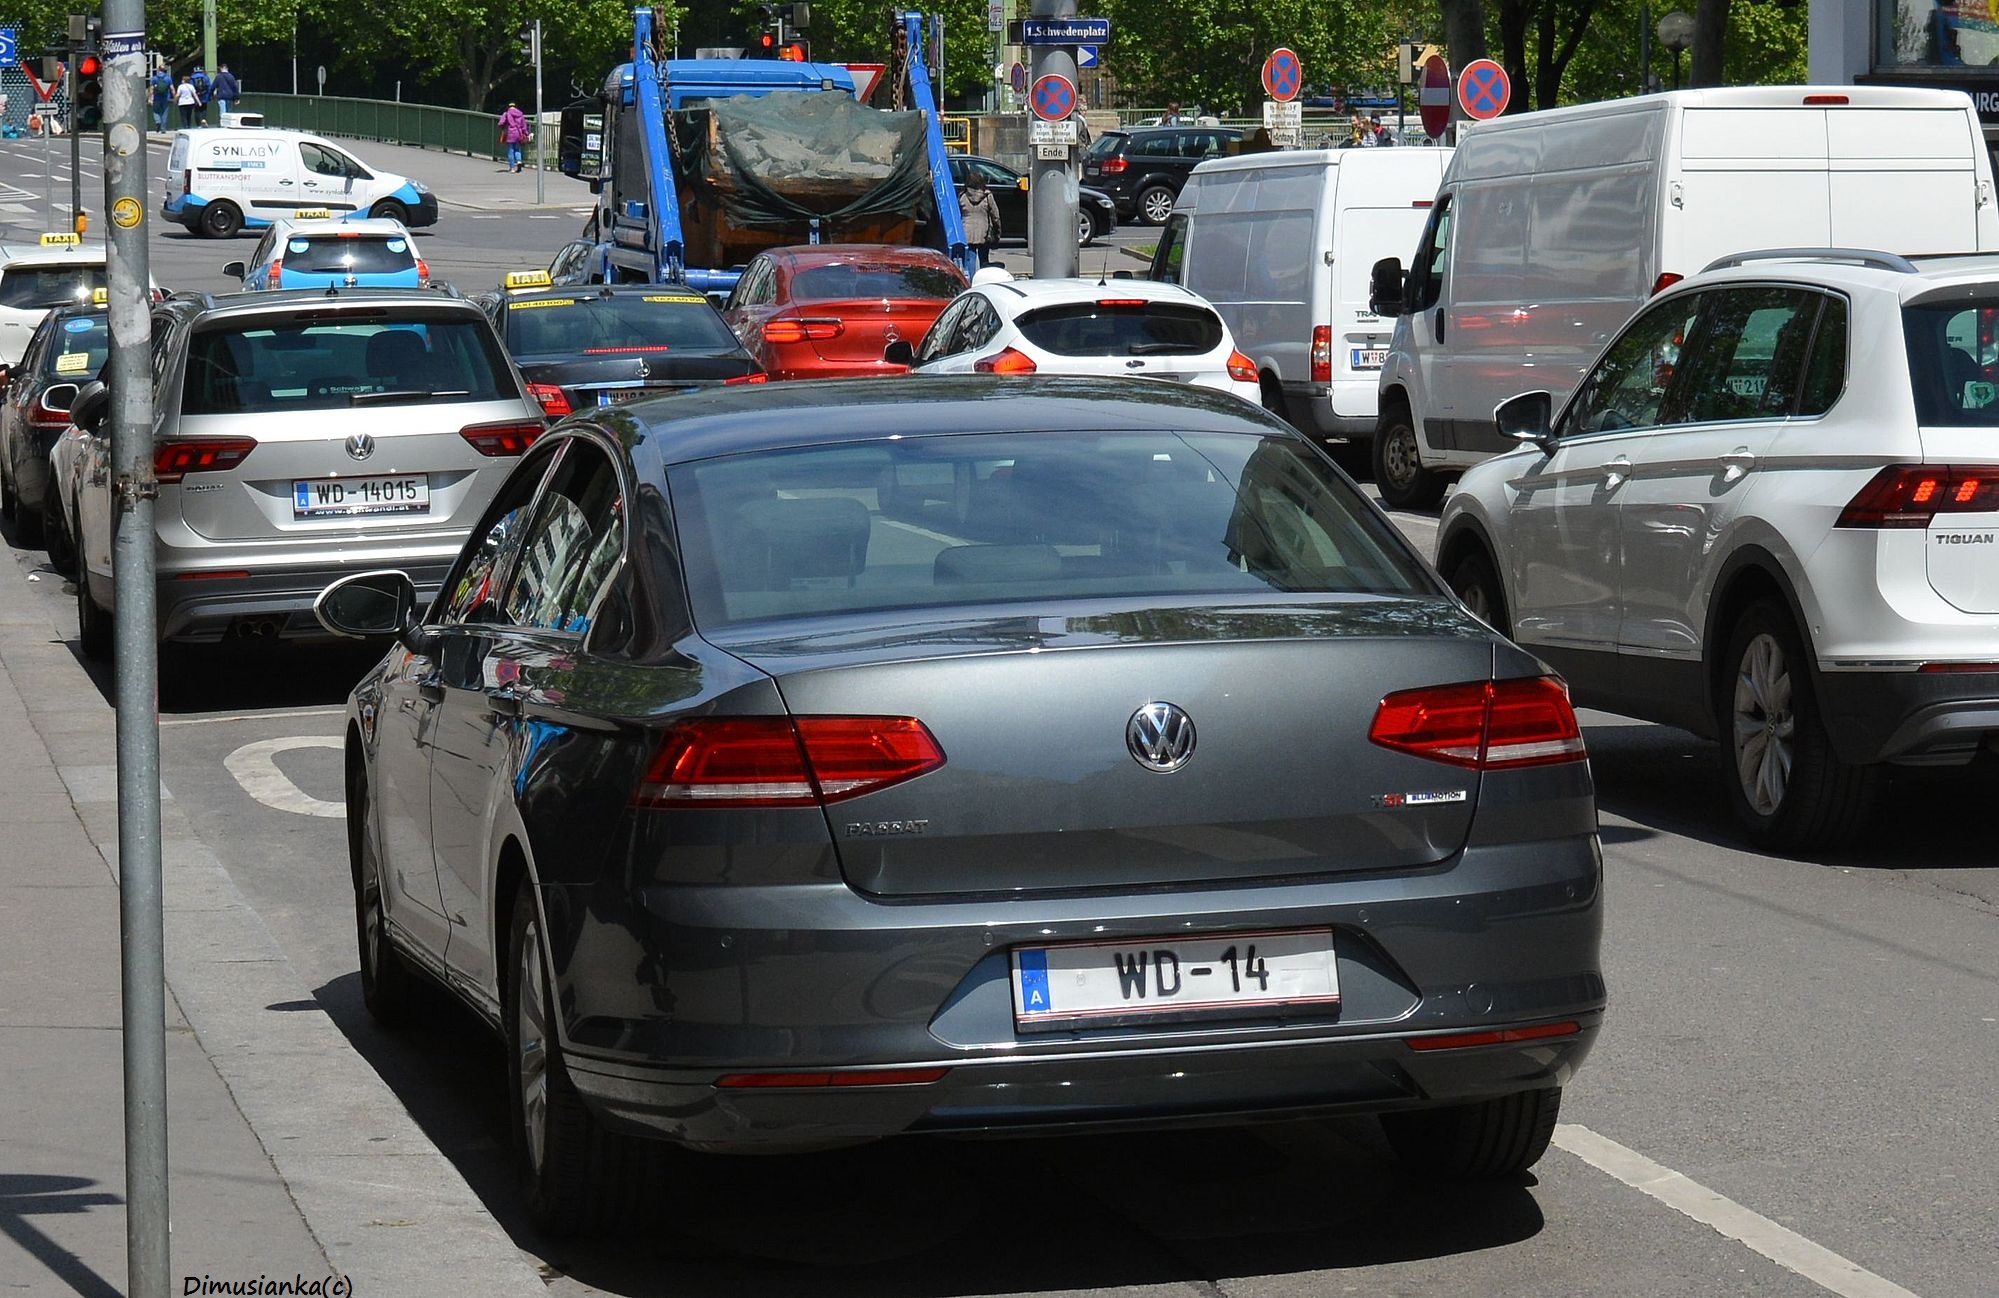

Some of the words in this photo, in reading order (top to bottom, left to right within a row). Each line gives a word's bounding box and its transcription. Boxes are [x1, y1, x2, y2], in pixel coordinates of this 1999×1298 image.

[213, 146, 265, 156] SYNLAB
[1042, 147, 1063, 157] Ende
[45, 235, 75, 243] TAXI
[513, 273, 546, 284] TAXI
[316, 480, 416, 504] WD-14015
[1936, 534, 1994, 544] TIGUAN
[846, 820, 928, 837] PASSAT
[1030, 990, 1043, 1005] A
[1114, 944, 1269, 1000] WD-14
